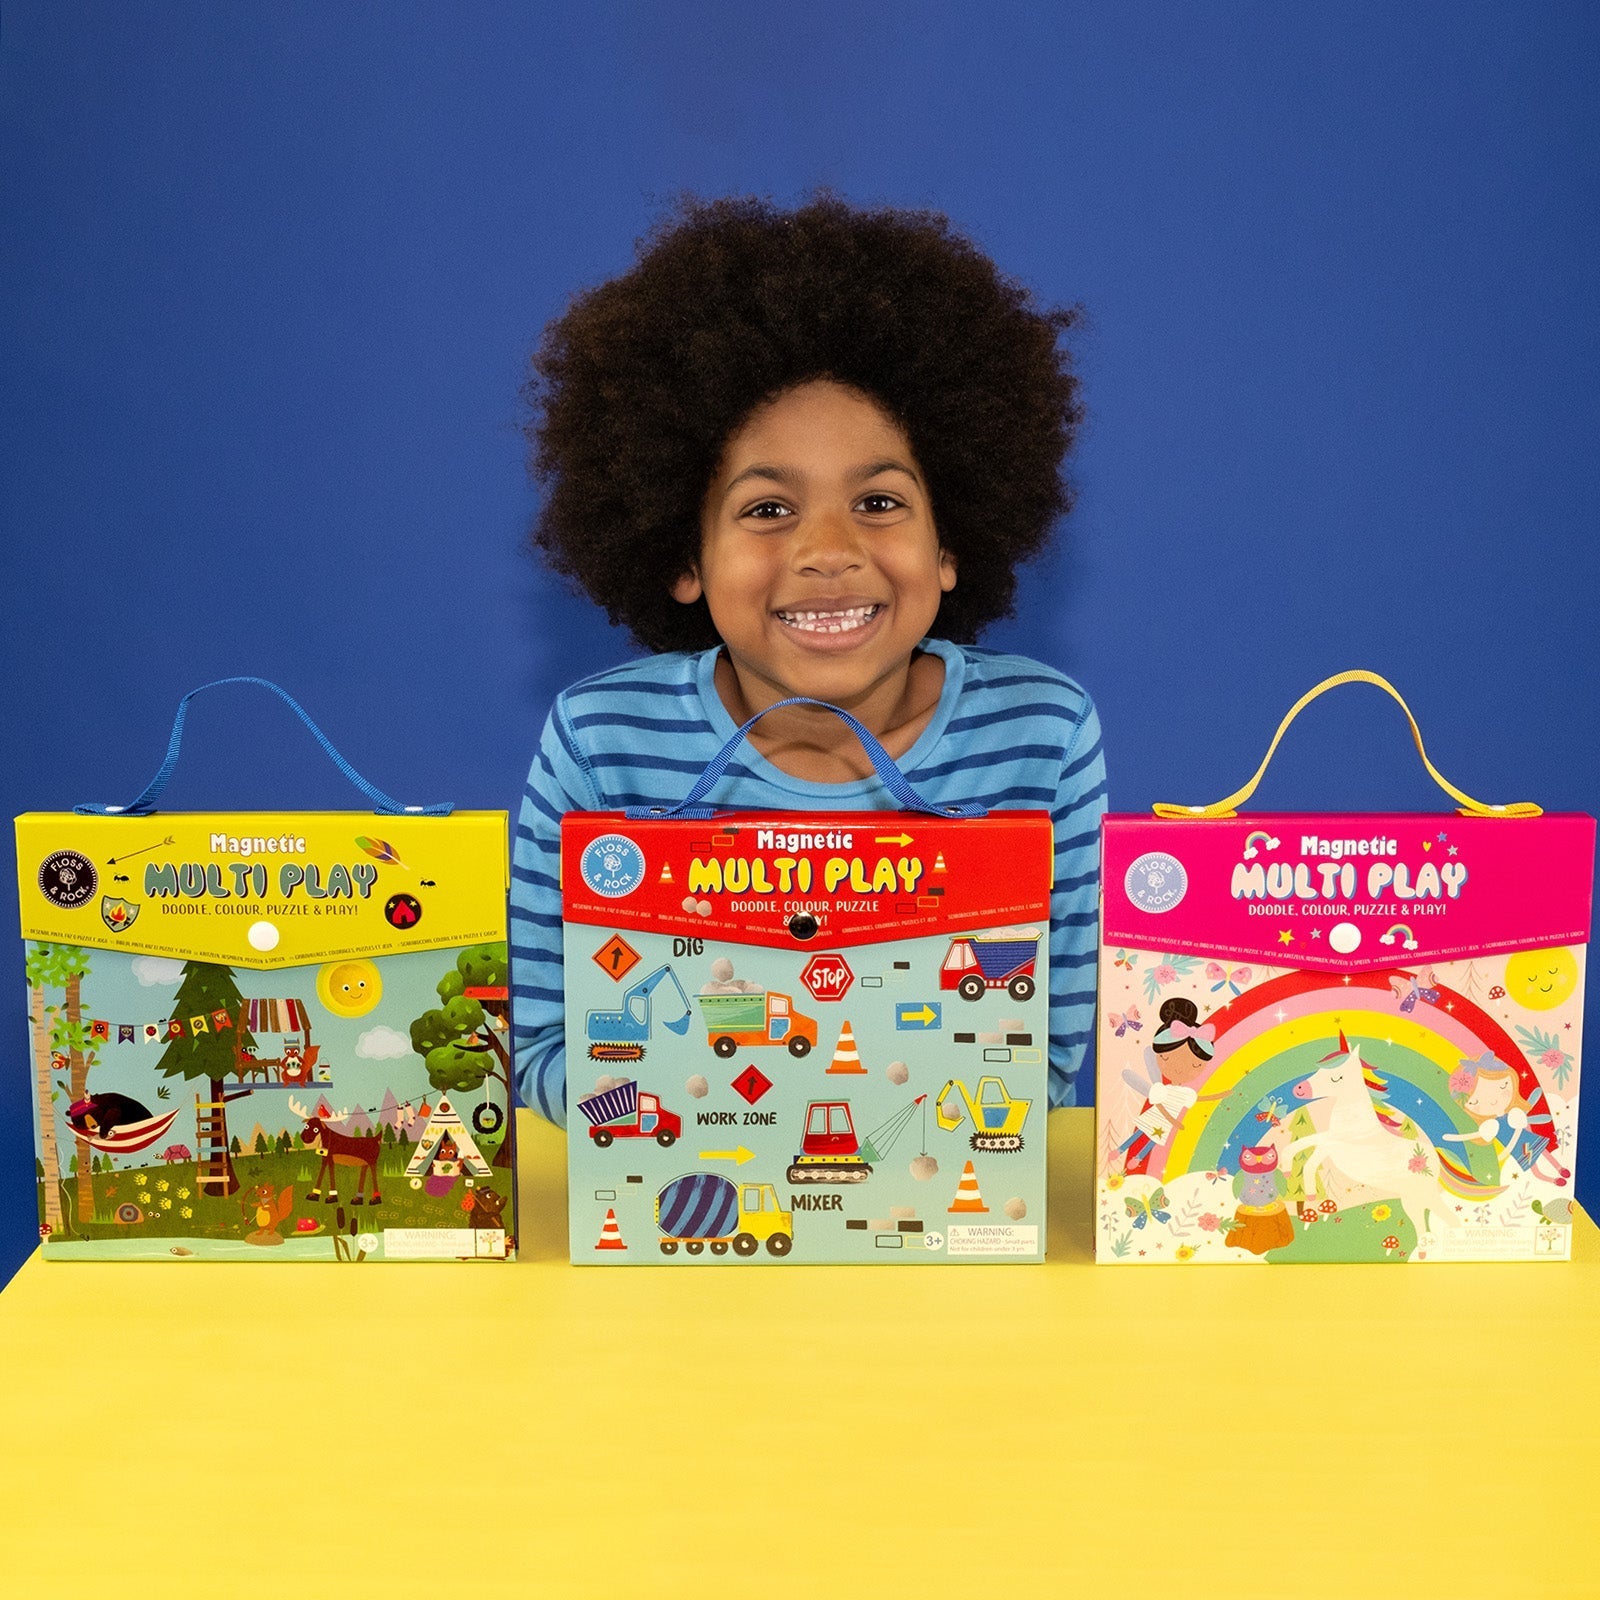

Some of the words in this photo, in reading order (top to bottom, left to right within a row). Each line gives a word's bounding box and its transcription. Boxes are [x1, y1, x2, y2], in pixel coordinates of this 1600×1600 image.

[210, 833, 306, 857] Magnetic
[758, 830, 853, 852] Magnetic
[1301, 836, 1397, 860] Magnetic
[595, 844, 629, 858] FLOSS
[50, 858, 83, 872] FLOSS
[1139, 860, 1173, 876] FLOSS
[144, 862, 266, 898] MULTI
[279, 862, 378, 898] PLAY
[594, 873, 602, 882] &
[604, 872, 633, 889] ROCK
[688, 857, 812, 894] MULTI
[824, 857, 923, 894] PLAY
[1230, 862, 1357, 900] MULTI
[1367, 862, 1468, 900] PLAY
[50, 886, 58, 896] &
[60, 888, 88, 902] ROCK
[1137, 889, 1145, 898] &
[1147, 890, 1174, 906] ROCK
[266, 904, 309, 916] PUZZLE
[314, 904, 322, 916] &
[326, 904, 358, 916] PLAY!
[836, 901, 879, 912] PUZZLE
[1354, 904, 1397, 916] PUZZLE
[1401, 904, 1410, 916] &
[1414, 904, 1446, 916] PLAY!
[812, 968, 845, 989] STOP
[697, 1112, 737, 1125] WORK
[742, 1112, 777, 1126] ZONE
[404, 1230, 456, 1240] WARNING:
[968, 1228, 1014, 1236] WARNING:
[1464, 1229, 1516, 1238] WARNING:
[360, 1238, 376, 1247] 3+
[926, 1236, 942, 1246] 3+
[1421, 1236, 1436, 1246] 3+
